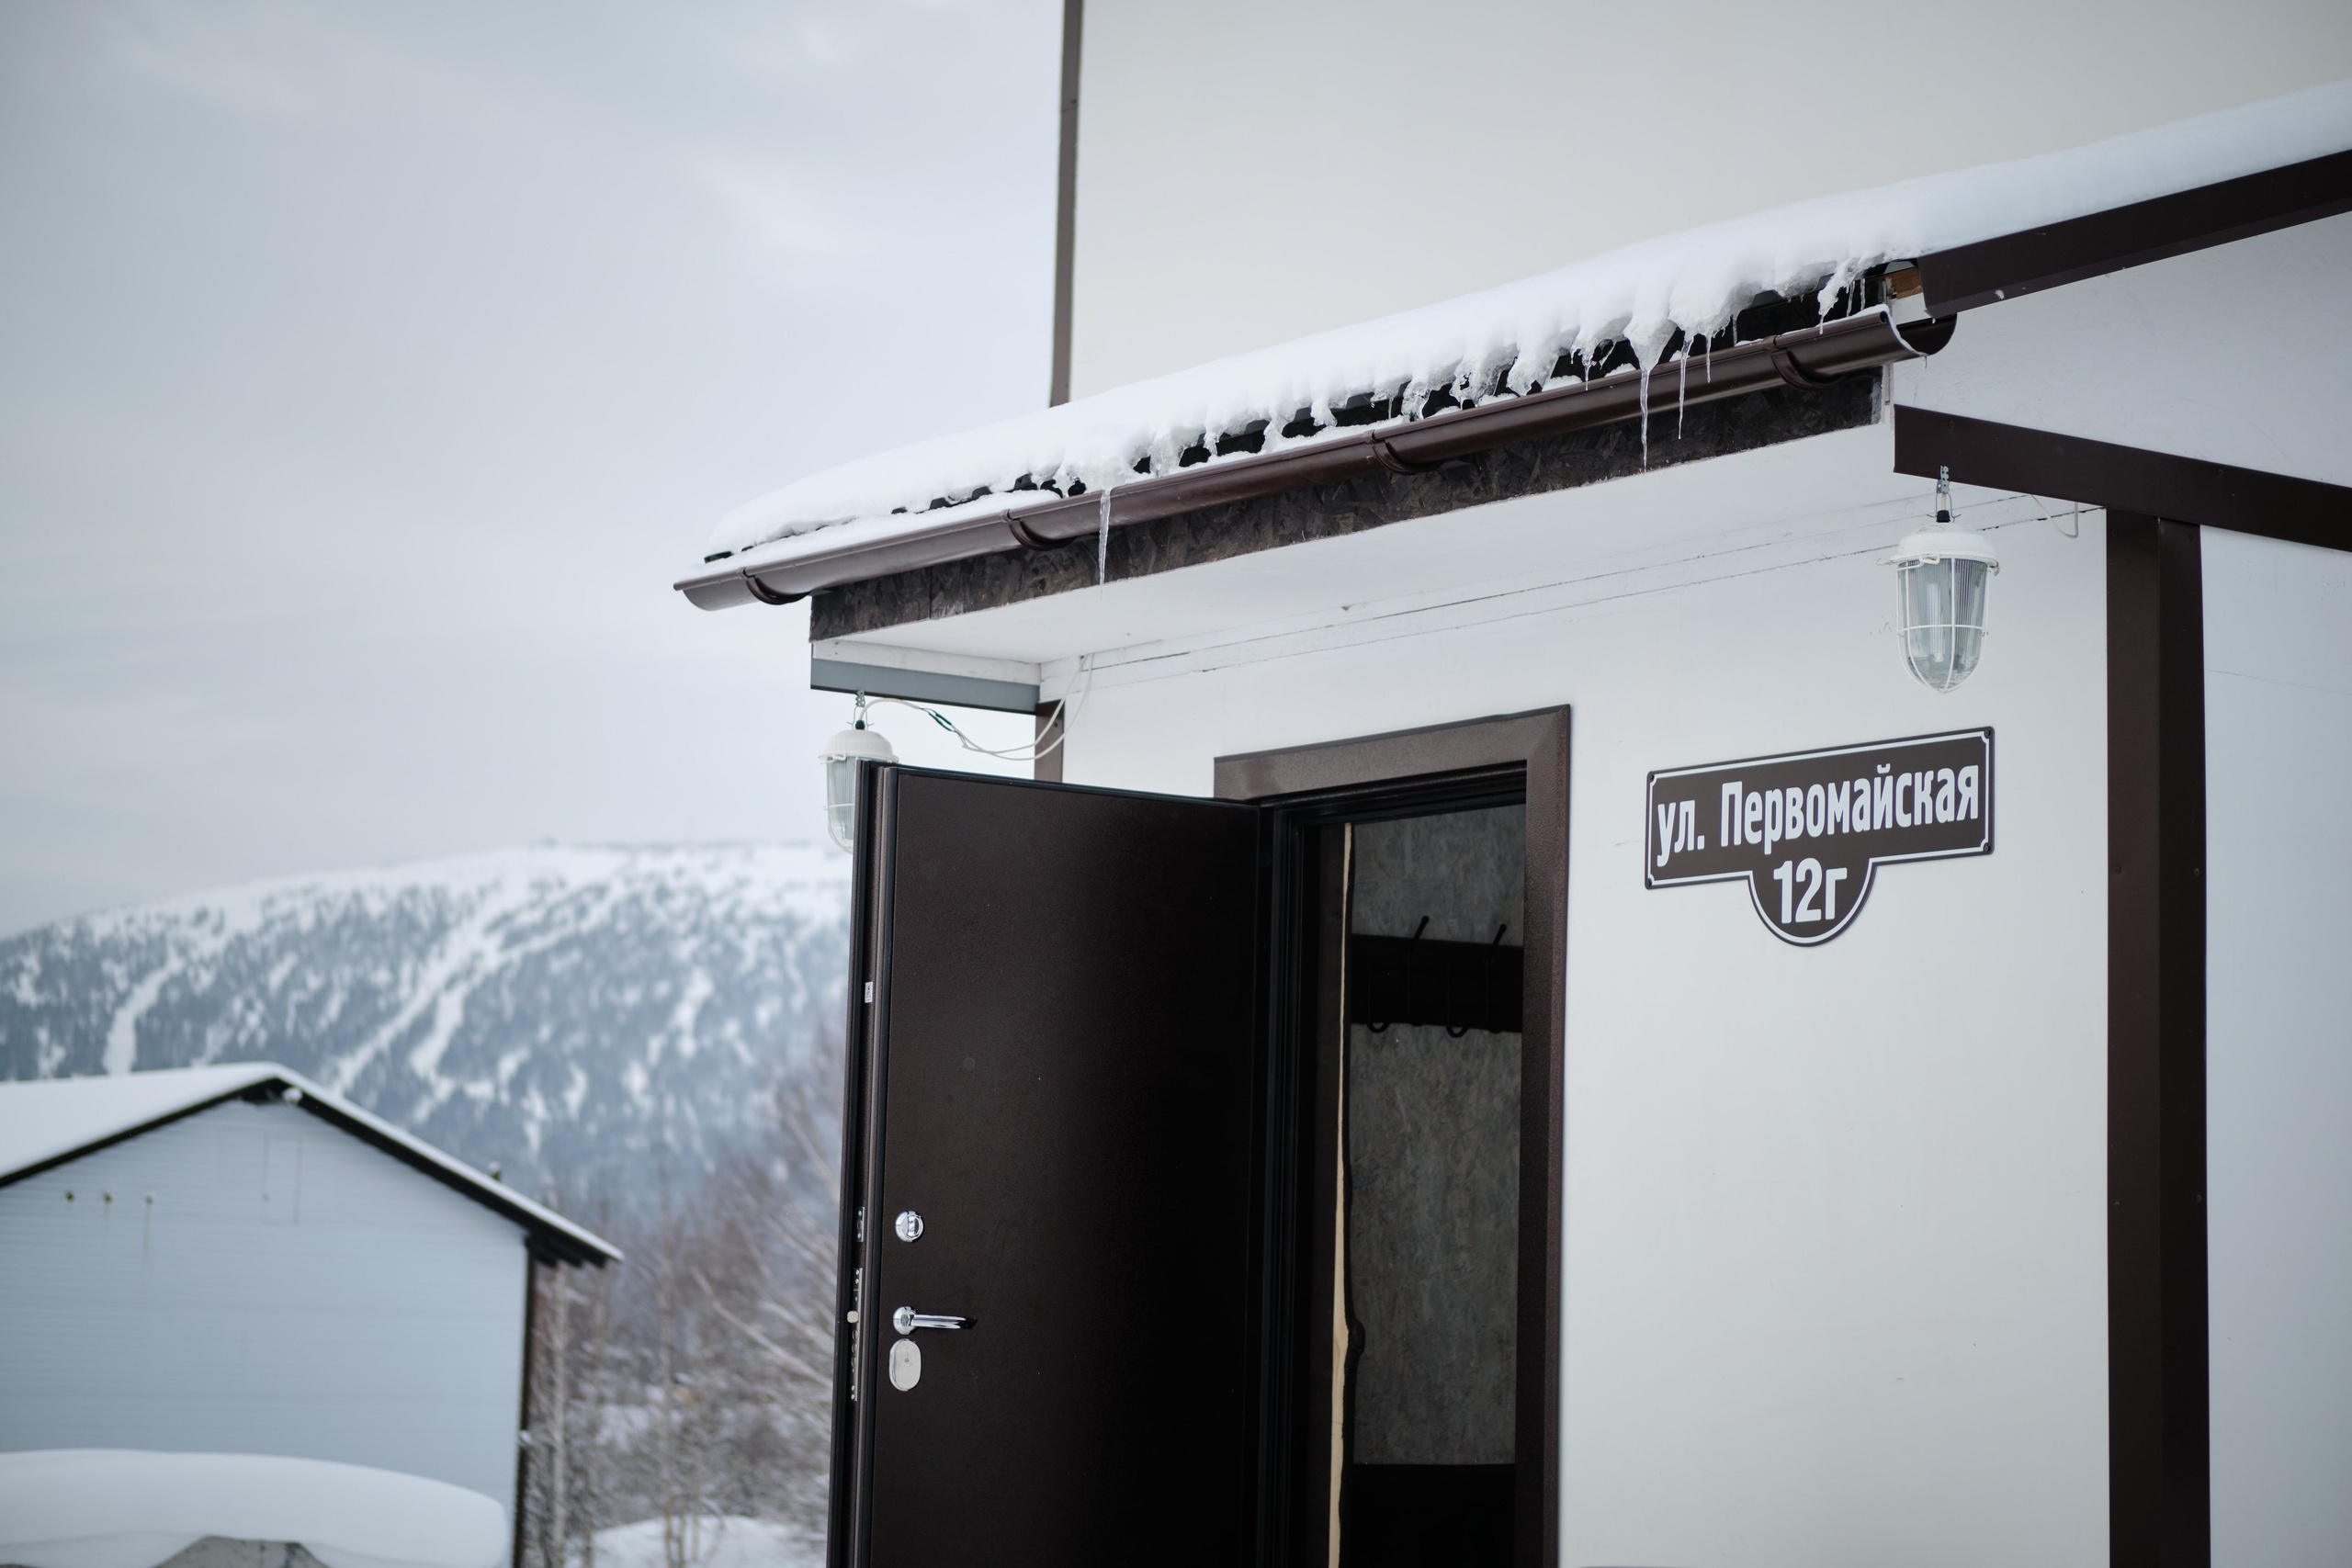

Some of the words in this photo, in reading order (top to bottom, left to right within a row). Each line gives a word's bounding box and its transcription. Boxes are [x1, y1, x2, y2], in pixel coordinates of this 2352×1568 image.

[1657, 799, 1705, 867] ул.
[1720, 763, 1979, 855] Первомайская
[1773, 857, 1848, 924] 12г
